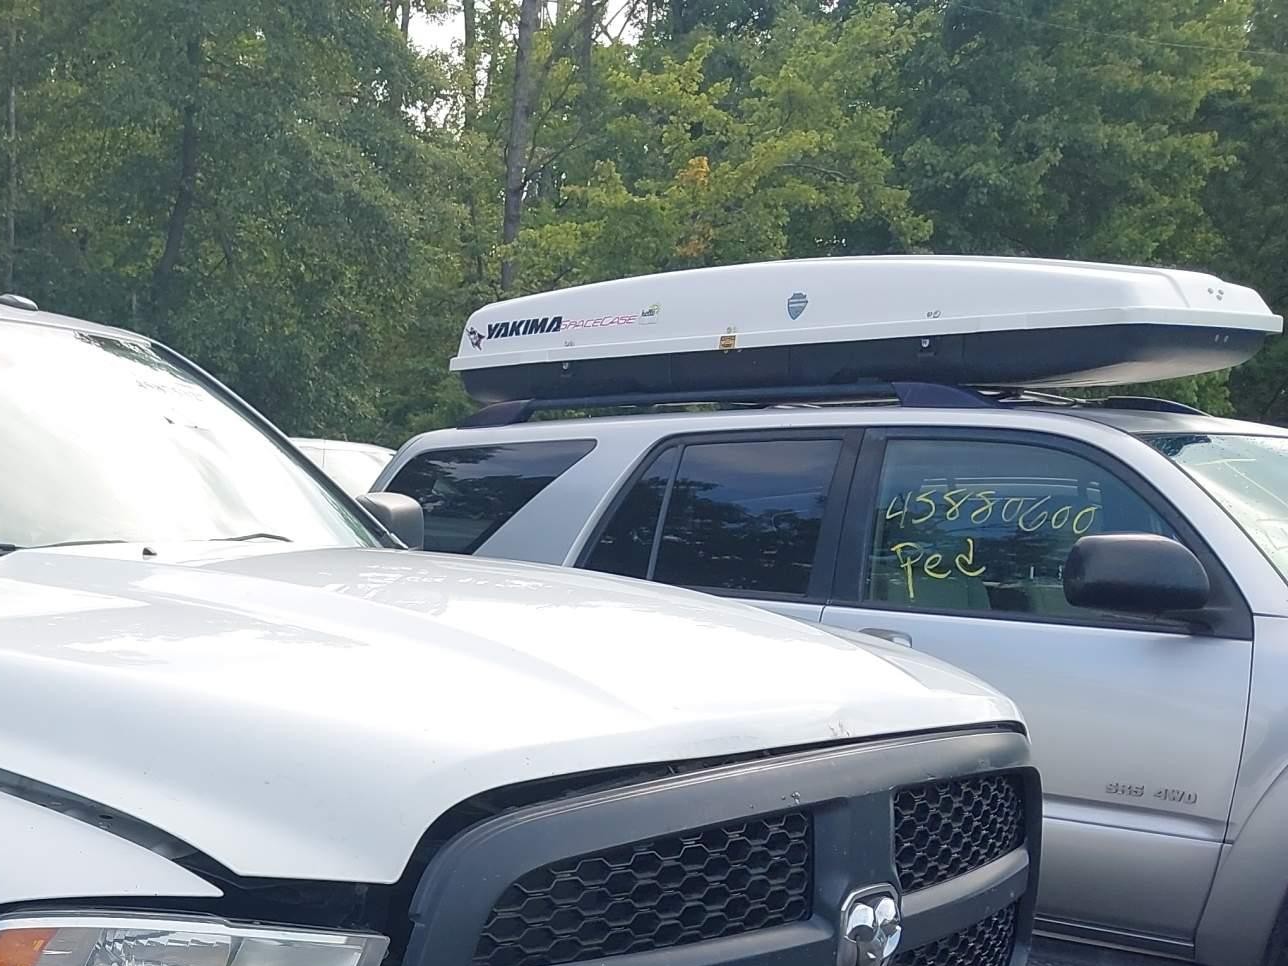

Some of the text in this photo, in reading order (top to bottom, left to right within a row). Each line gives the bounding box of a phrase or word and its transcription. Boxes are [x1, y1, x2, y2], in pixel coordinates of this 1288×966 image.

[487, 316, 562, 340] YAKIMA
[885, 488, 1097, 535] 45880600
[1153, 788, 1199, 805] 4WD
